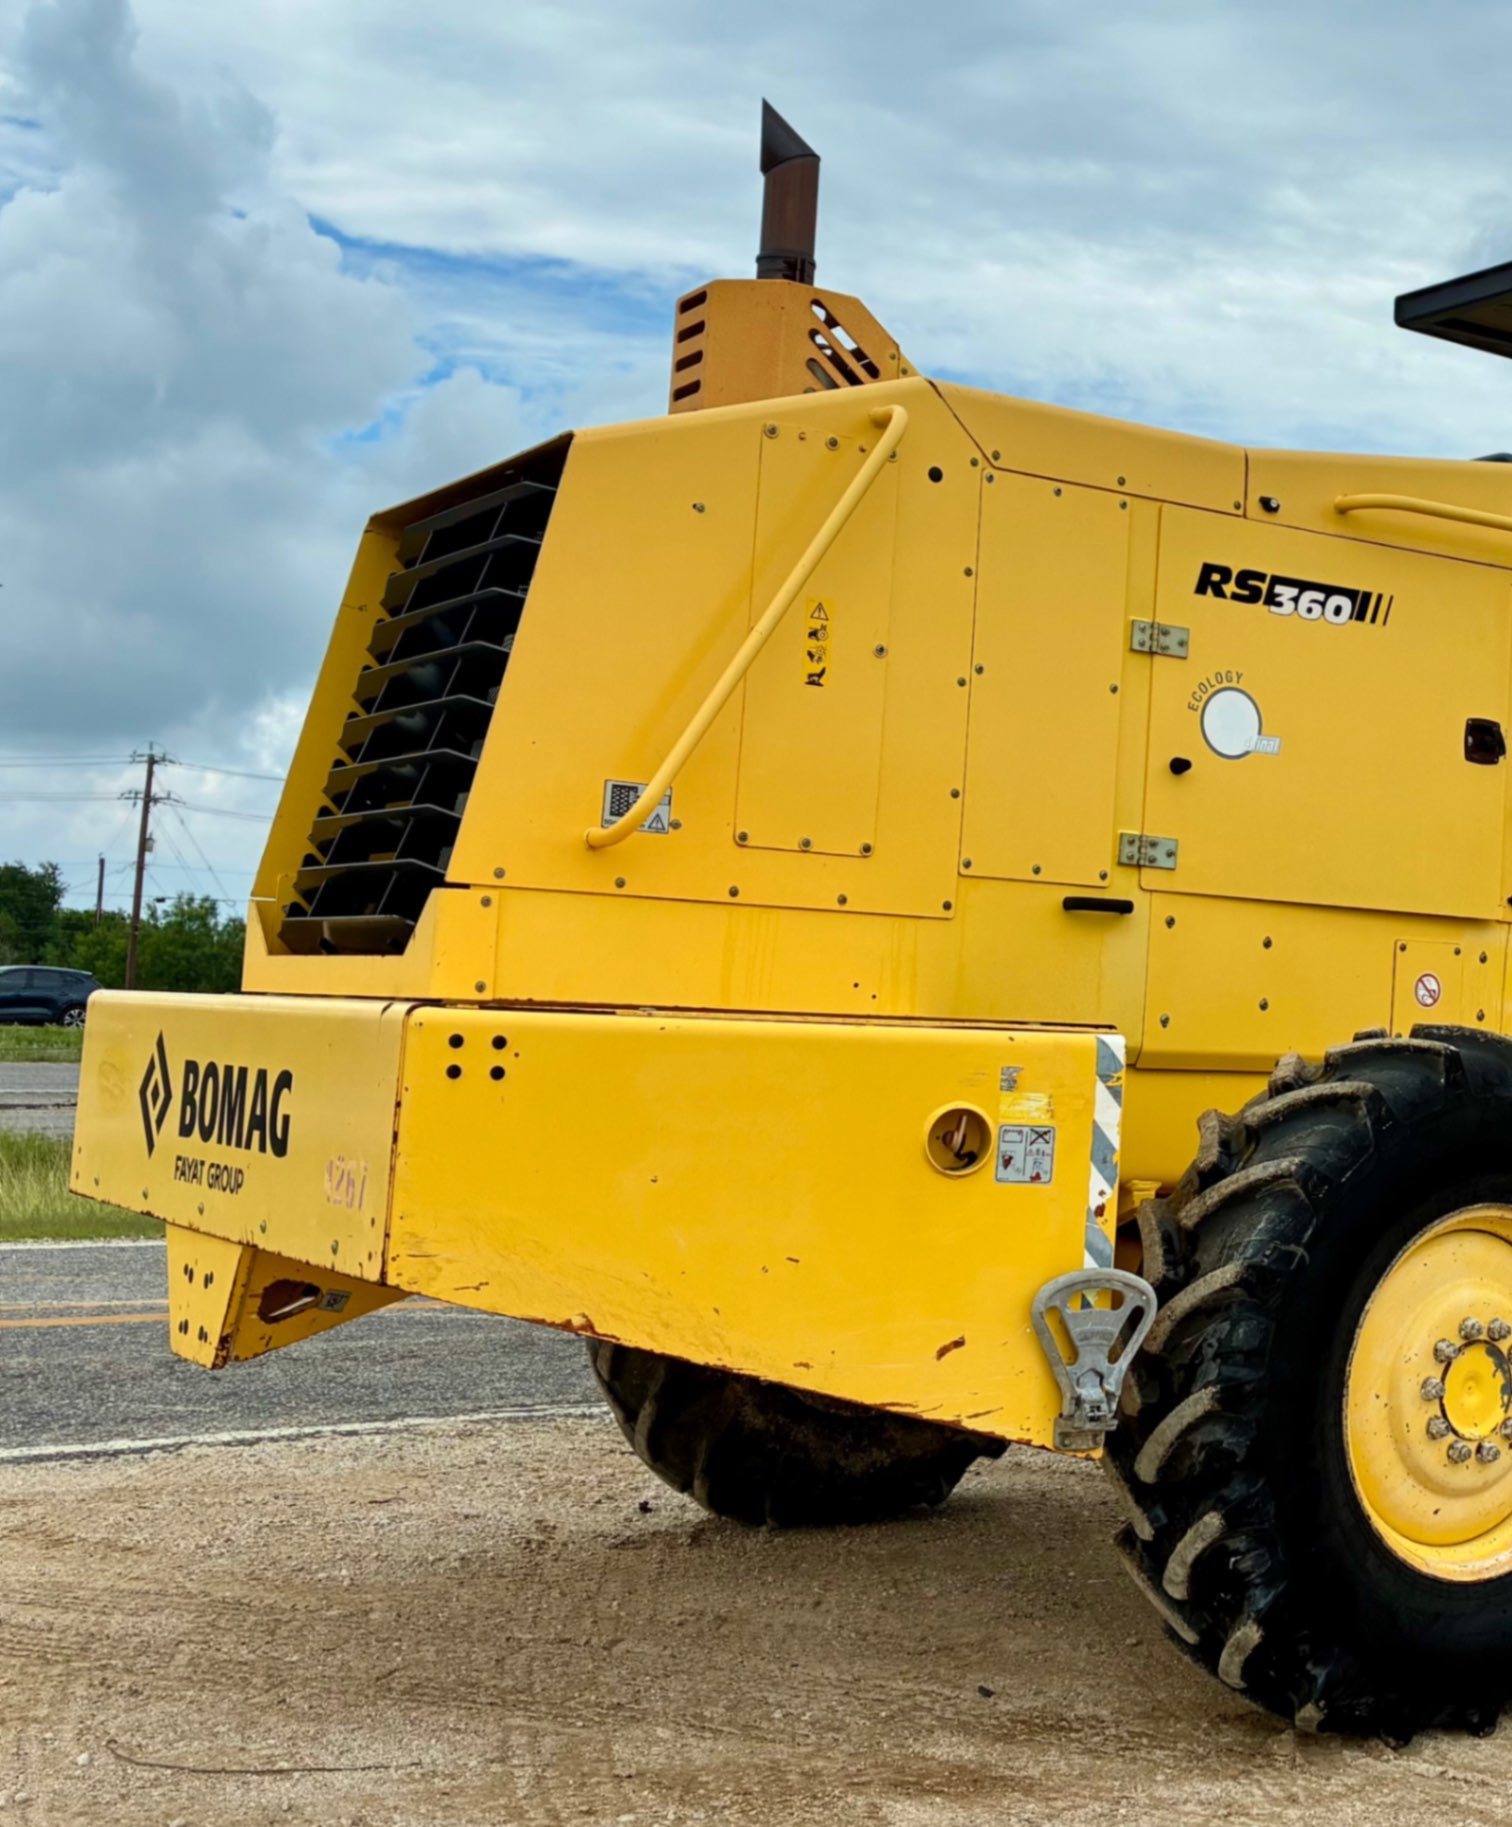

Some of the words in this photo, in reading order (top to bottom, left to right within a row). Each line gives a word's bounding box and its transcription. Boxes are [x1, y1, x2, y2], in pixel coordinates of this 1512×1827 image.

[1187, 670, 1243, 712] ECOLOGY
[178, 1059, 293, 1158] BOMAG
[174, 1155, 205, 1186] FAYAT
[207, 1162, 244, 1195] GROUP
